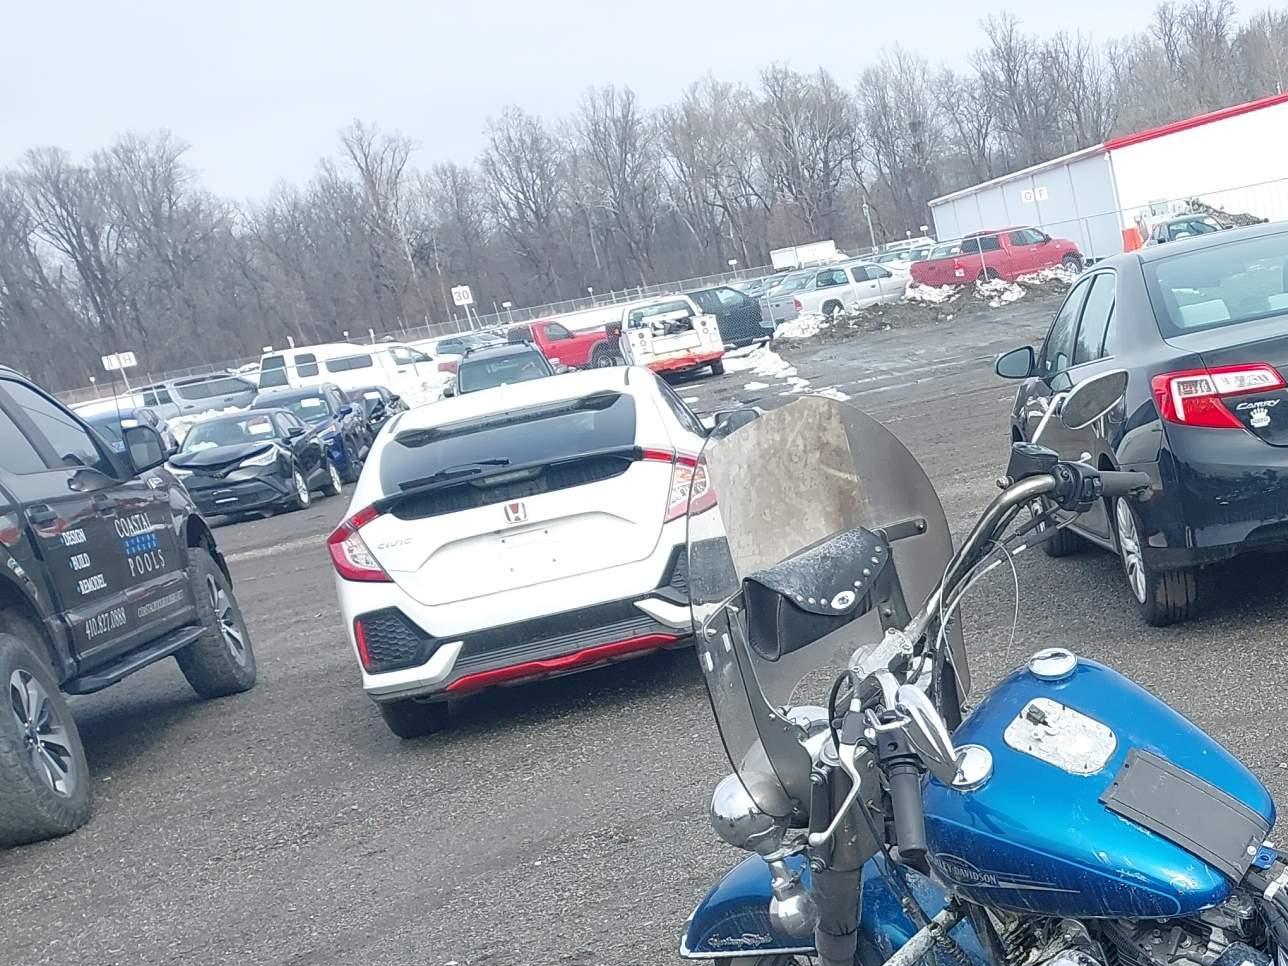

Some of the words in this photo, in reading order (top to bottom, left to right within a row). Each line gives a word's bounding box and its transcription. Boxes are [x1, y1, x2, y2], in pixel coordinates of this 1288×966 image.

[454, 290, 470, 302] 30
[114, 513, 153, 538] COASTAL
[62, 528, 87, 546] DESIGN
[128, 549, 166, 576] POOLS
[78, 574, 107, 595] REMODEL
